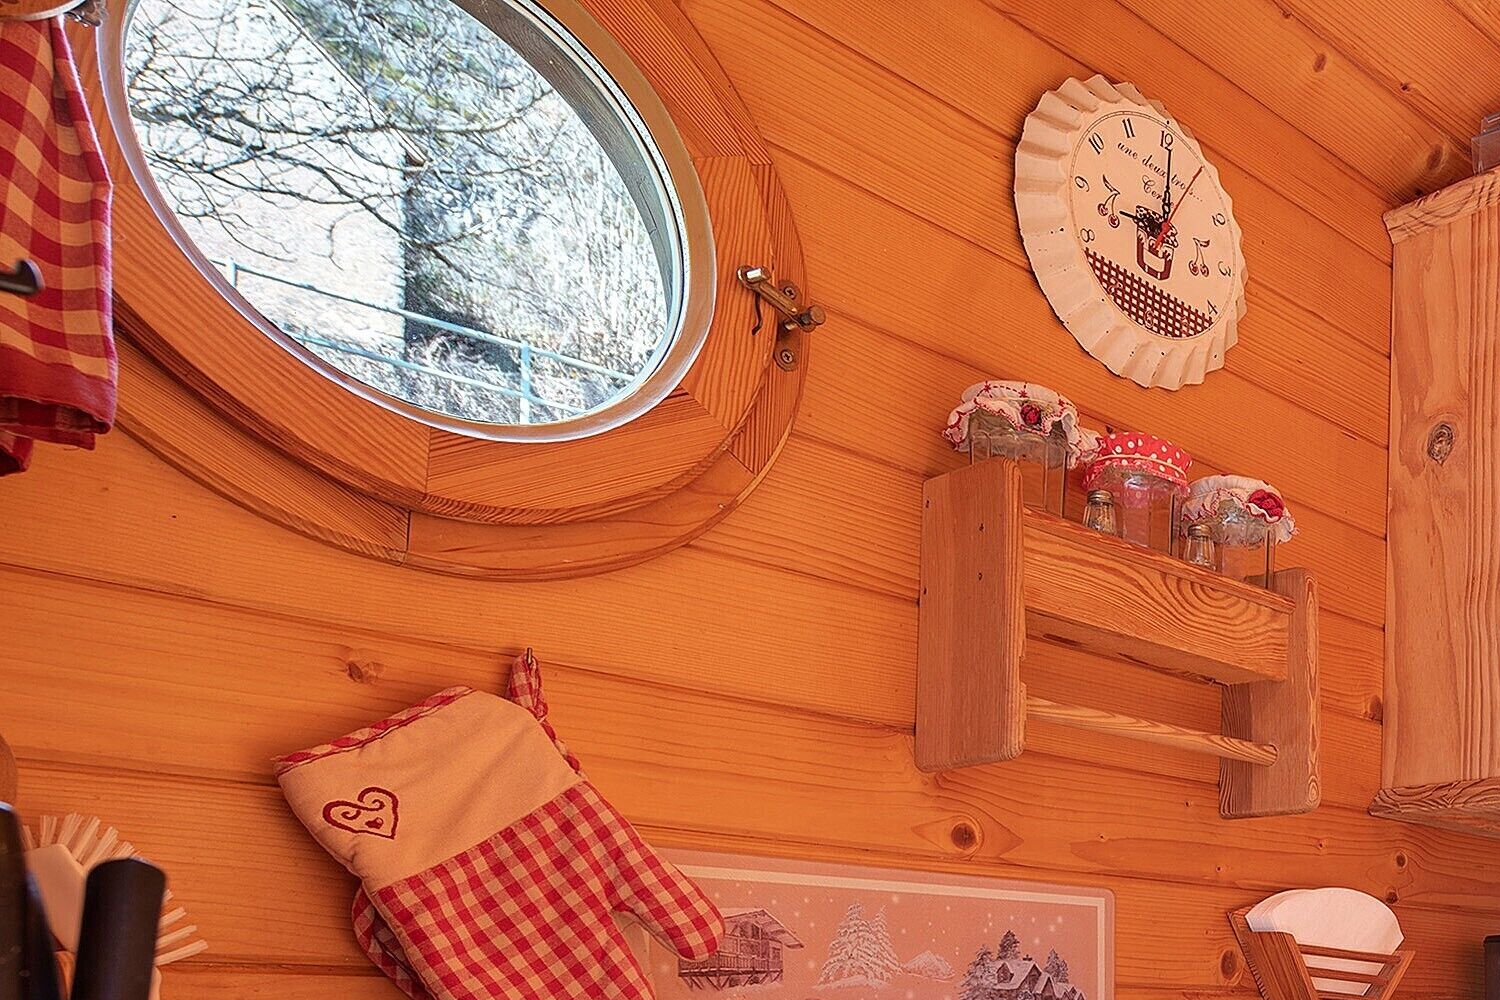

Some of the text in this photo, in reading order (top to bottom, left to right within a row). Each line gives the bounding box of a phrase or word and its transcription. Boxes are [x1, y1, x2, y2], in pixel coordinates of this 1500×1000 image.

[1121, 118, 1136, 139] 11
[1088, 132, 1105, 156] 10
[1117, 142, 1138, 160] une
[1074, 175, 1090, 193] 9
[1080, 228, 1096, 243] 8
[1217, 260, 1232, 278] 3
[1206, 299, 1219, 316] 4
